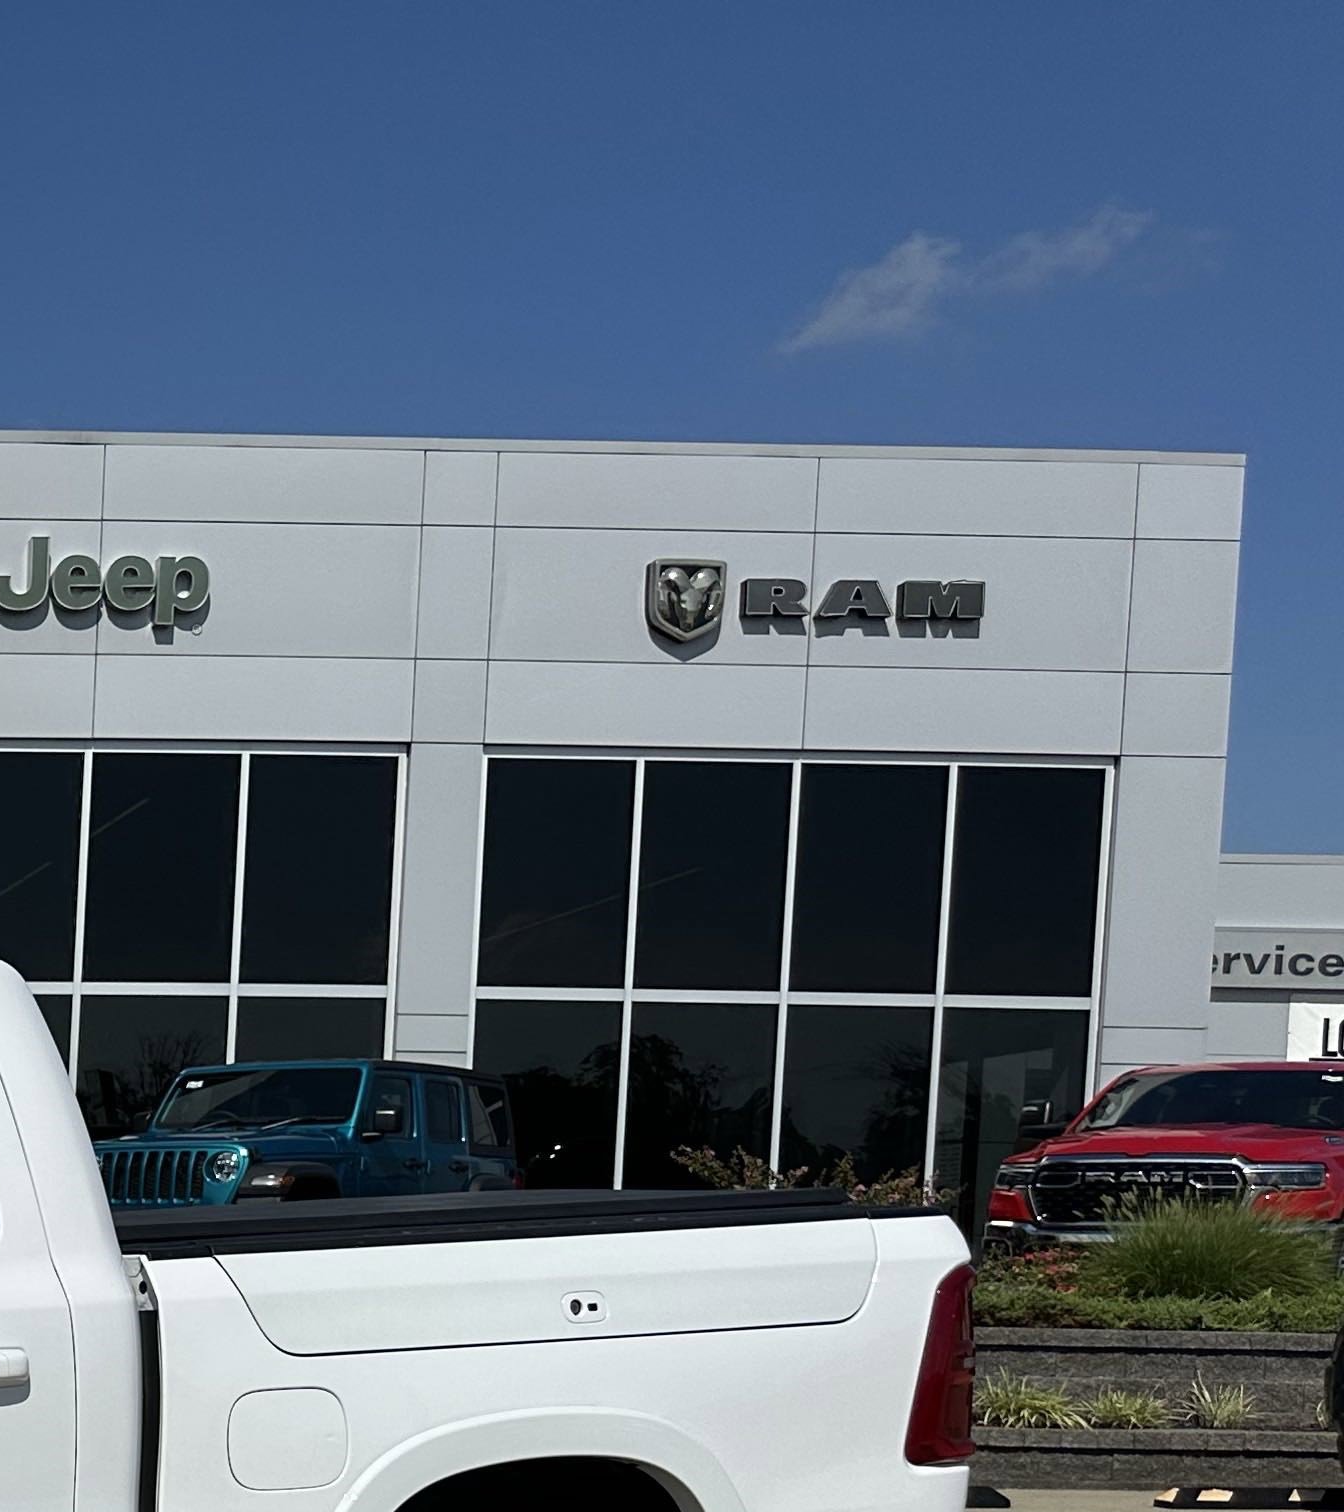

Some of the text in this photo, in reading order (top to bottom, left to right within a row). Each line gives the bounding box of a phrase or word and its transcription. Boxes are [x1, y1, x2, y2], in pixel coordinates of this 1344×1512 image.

[739, 577, 986, 618] RAM
[1212, 944, 1344, 977] rvice
[1084, 1171, 1184, 1184] RAM
